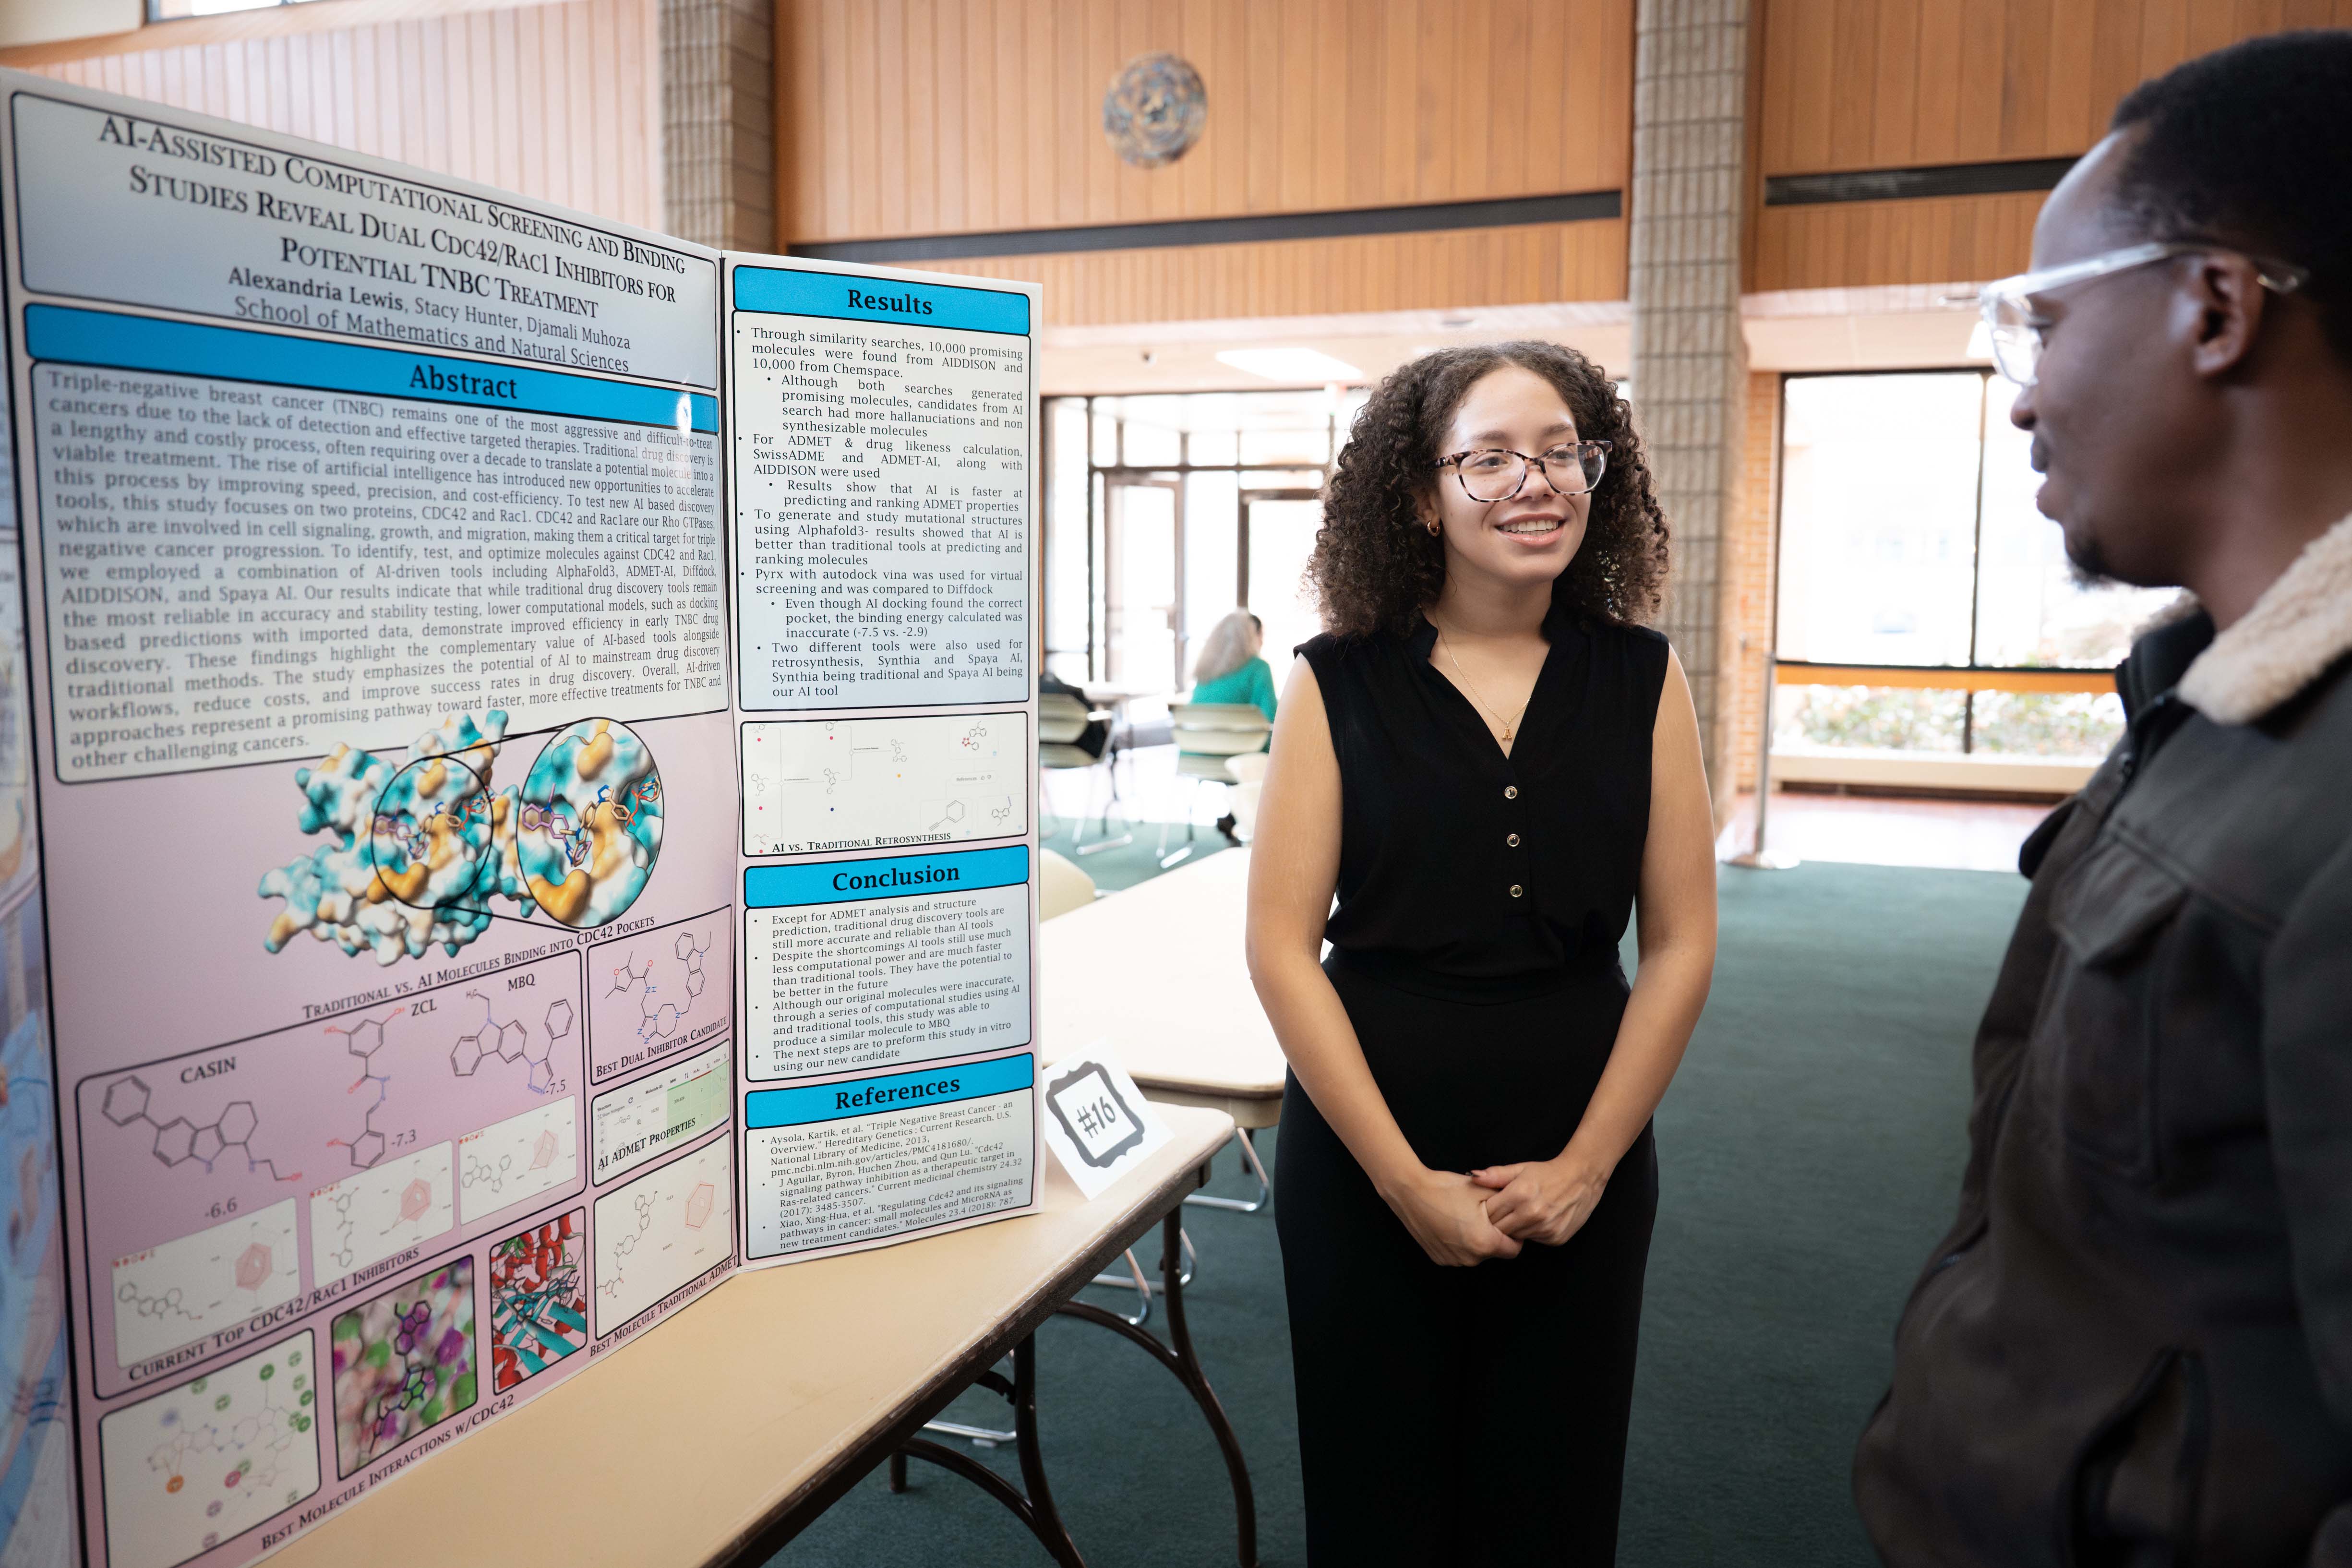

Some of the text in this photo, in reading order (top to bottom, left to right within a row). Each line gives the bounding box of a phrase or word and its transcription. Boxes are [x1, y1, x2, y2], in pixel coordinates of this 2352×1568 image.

[99, 117, 276, 177] AI-ASSISTED
[284, 156, 482, 224] COMPUTATIONAL
[488, 204, 582, 248] SCREENING
[623, 240, 685, 274] BINDING
[130, 165, 249, 213] STUDIES
[257, 190, 354, 235] REVEAL
[360, 213, 425, 249] DUAL
[555, 256, 643, 296] INHIBITORS
[281, 237, 599, 318] POTENTIAL TNBC TREATMENT
[228, 267, 631, 350] Alexandria Lewis, Stacy Hunter, Djamali Muhoza
[848, 289, 933, 315] Results
[232, 296, 629, 372] School of Mathematics and Natural Sciences
[751, 327, 1023, 361] Through similarity searches, 10,000 promising
[752, 343, 1022, 373] molecules were found from AIDDISON and
[754, 358, 903, 379] 10,000 from Chemspace.
[409, 364, 517, 399] Abstract
[48, 370, 199, 400] Triple-negative
[208, 384, 262, 406] breast
[271, 395, 324, 412] cancer
[333, 398, 384, 418] (TNBC)
[392, 407, 447, 423] remains
[455, 414, 479, 426] one
[486, 414, 499, 428] of
[505, 416, 524, 430] the
[531, 422, 557, 433] most
[565, 426, 618, 439] aggressive
[624, 429, 641, 442] and
[756, 569, 783, 581] Pyrx
[790, 568, 816, 579] with
[823, 569, 877, 580] autodock
[939, 570, 964, 580] used
[970, 570, 986, 580] for
[990, 570, 1022, 581] virtual
[1502, 727, 1512, 739] A
[71, 735, 308, 769] other challenging cancers.
[772, 843, 784, 852] AI
[807, 838, 872, 850] TRADITIONAL
[875, 833, 951, 846] RETROSYNTHESIS
[833, 864, 960, 891] Conclusion
[772, 899, 976, 925] Except for ADMET analysis and structure
[772, 908, 1005, 939] prediction, traditional drug discovery tools are
[302, 987, 391, 1019] TRADITIONAL
[418, 973, 432, 989] AI
[436, 957, 500, 984] MOLECULES
[504, 945, 546, 966] BINDING
[576, 925, 613, 946] CDC42
[617, 916, 654, 934] POCKETS
[508, 973, 535, 992] MBQ
[411, 999, 437, 1017] ZCL
[596, 1017, 726, 1077] BEST DUAL INHIBITOR CANDIDATE
[180, 1057, 236, 1084] CASIN
[542, 1078, 566, 1095] -7.5
[836, 1079, 960, 1110] References
[770, 1134, 805, 1145] Aysola,
[808, 1129, 838, 1140] Kartik,
[852, 1125, 863, 1134] al.
[900, 1114, 937, 1126] Negative
[939, 1109, 965, 1120] Breast
[967, 1104, 996, 1115] Cancer
[825, 1135, 873, 1148] Hereditary
[876, 1129, 913, 1140] Genetics
[920, 1122, 952, 1133] Current
[955, 1113, 994, 1127] Research,
[996, 1111, 1011, 1120] U.S.
[1077, 1096, 1116, 1138] #16
[391, 1129, 416, 1147] -7.3
[598, 1117, 696, 1170] AI ADMET PROPERTIES
[771, 1135, 930, 1166] National Library of Medicine, 2013,
[771, 1137, 973, 1178] pmc.ncbi.nlm.nih.gov/articles/PMC4181680/.
[204, 1197, 238, 1219] -6.6
[780, 1197, 866, 1219] (2017): 3485-3507.
[128, 1342, 205, 1382] CURRENT
[213, 1327, 244, 1348] TOP
[352, 1247, 420, 1286] INHIBITORS
[590, 1252, 740, 1357] BEST MOLECULE TRADITIONAL ADMET
[262, 1522, 294, 1550] BEST
[299, 1481, 364, 1528] MOLECULE
[369, 1430, 451, 1486] INTERACTIONS
